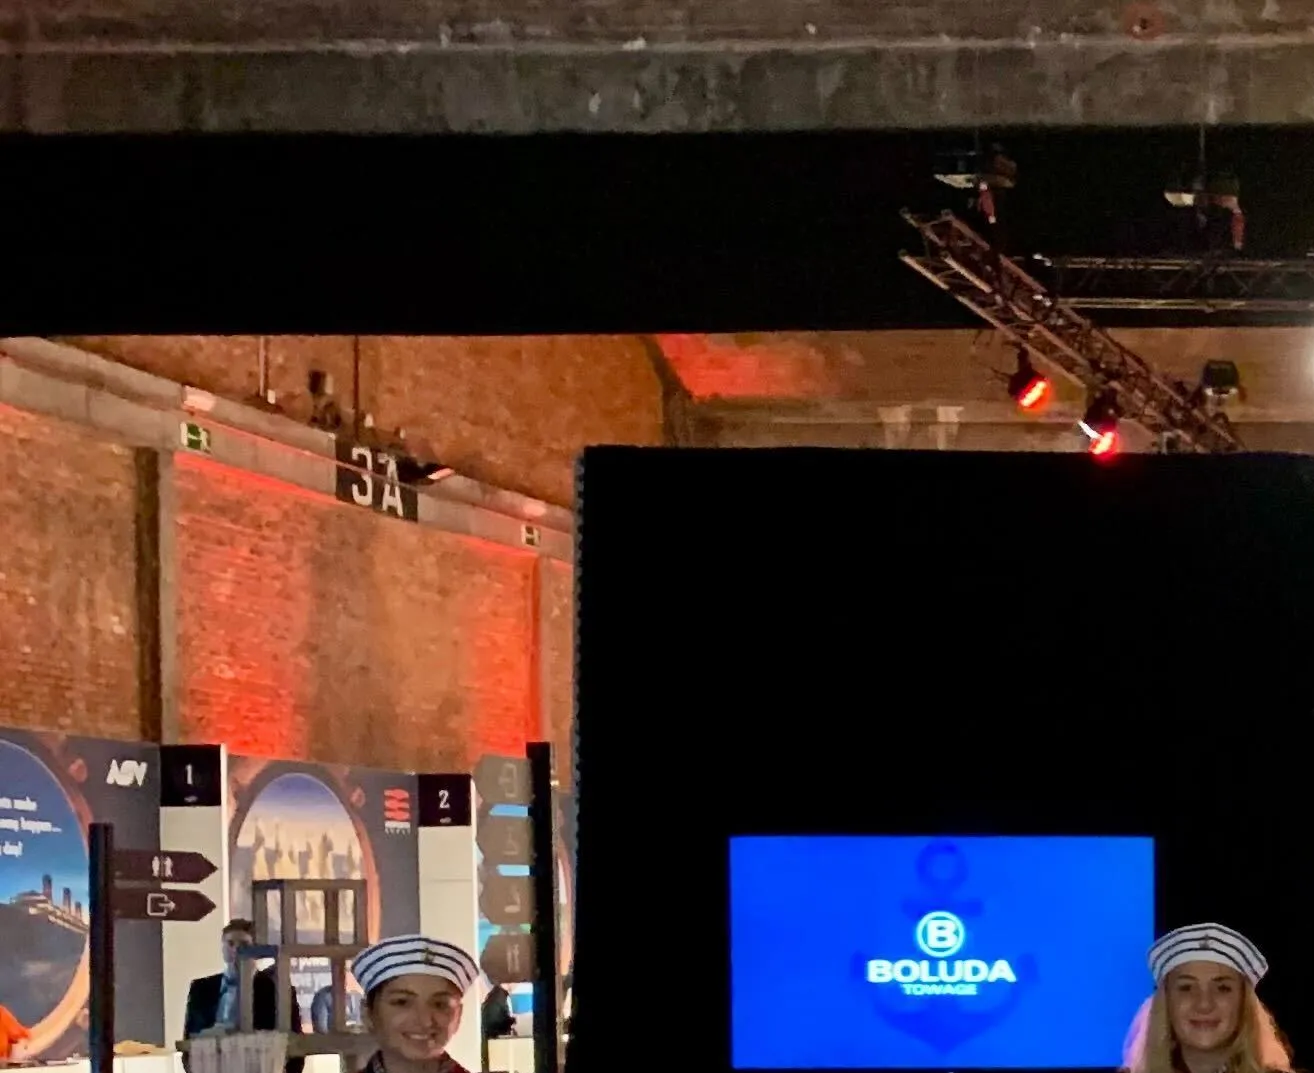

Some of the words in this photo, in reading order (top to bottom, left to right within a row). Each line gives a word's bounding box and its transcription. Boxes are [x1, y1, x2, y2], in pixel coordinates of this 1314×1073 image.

[184, 763, 194, 785] 1
[438, 789, 450, 809] 2
[926, 919, 959, 949] B
[867, 959, 1017, 983] BOLUDA
[902, 983, 978, 996] TOWAGE
